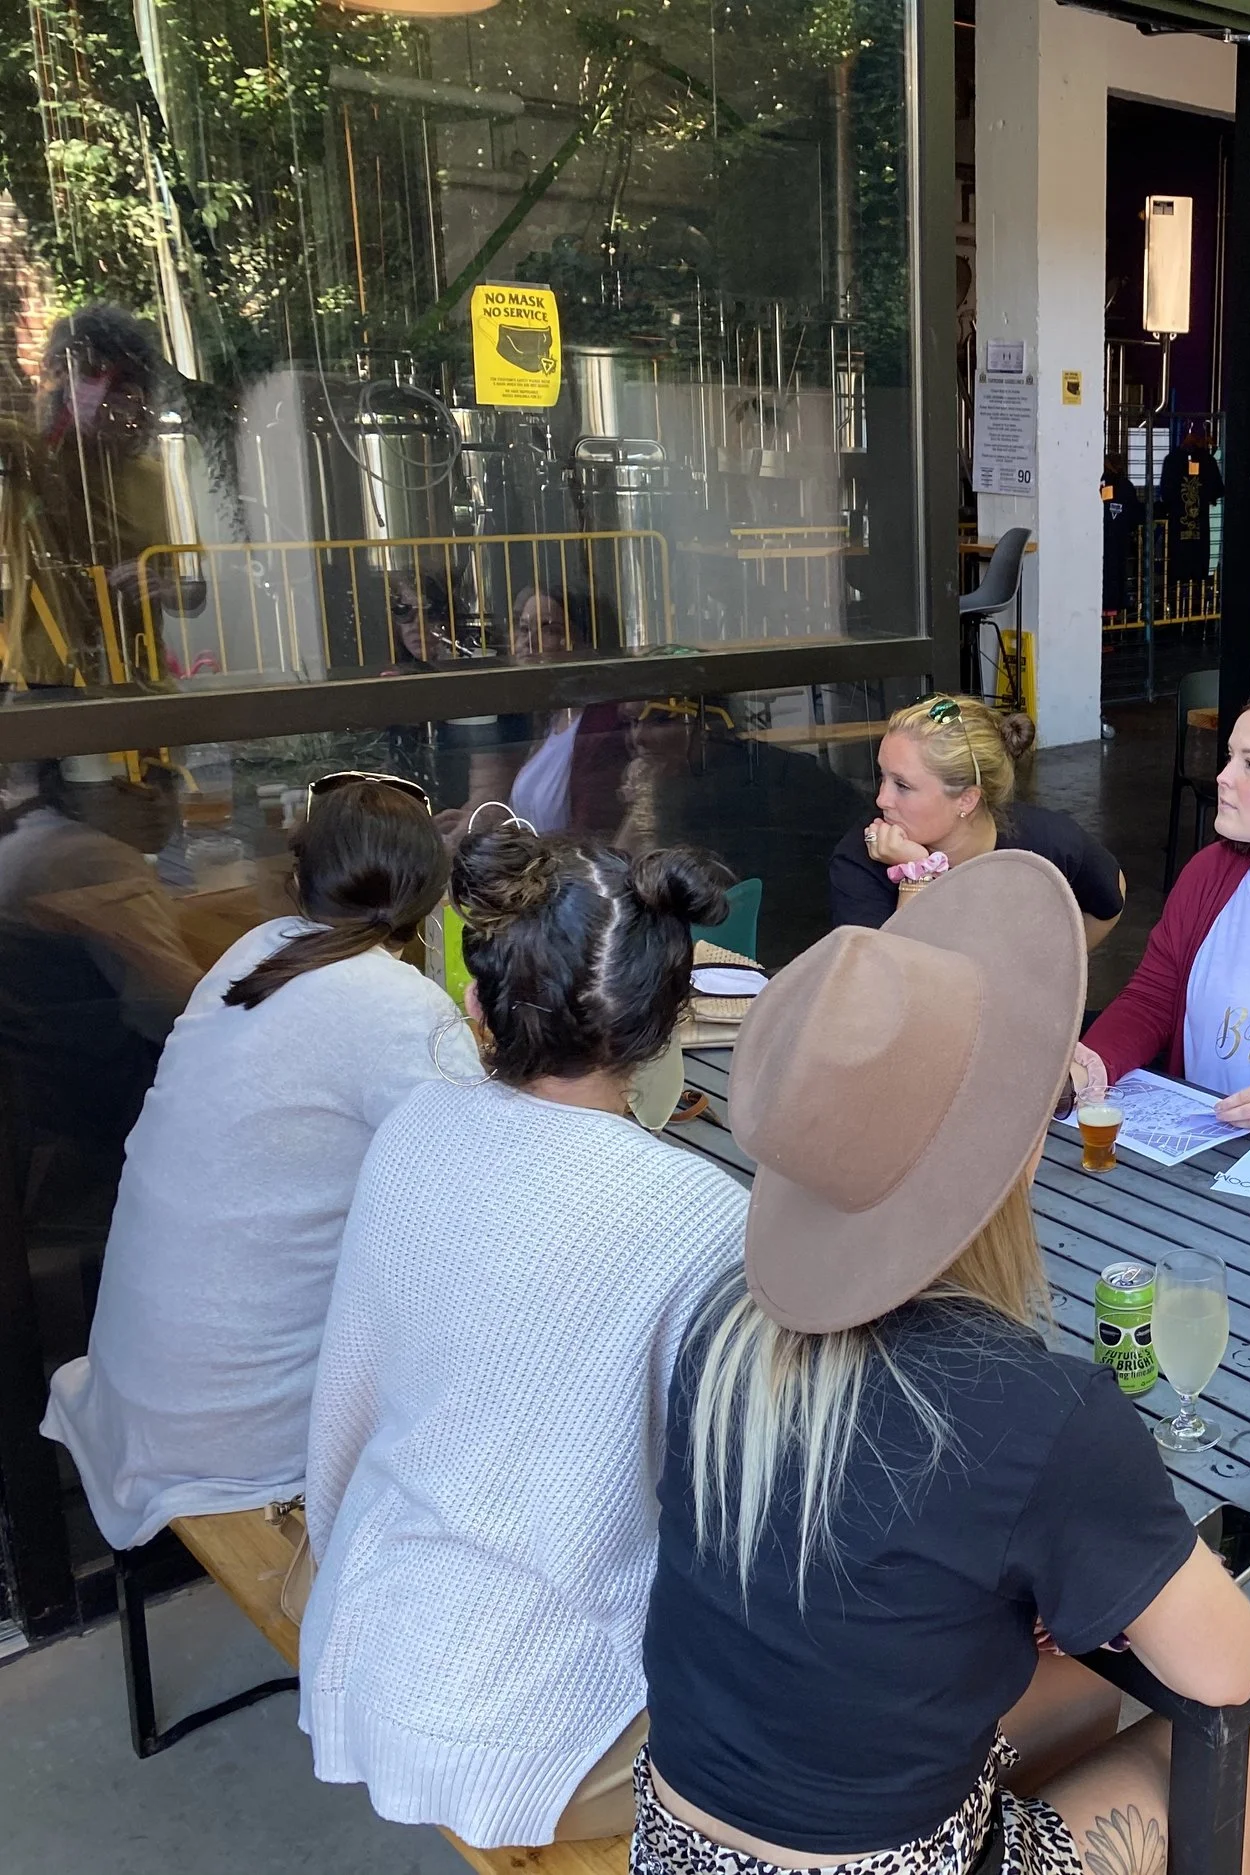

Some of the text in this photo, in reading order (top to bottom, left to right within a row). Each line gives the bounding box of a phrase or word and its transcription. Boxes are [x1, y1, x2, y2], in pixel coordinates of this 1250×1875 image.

[485, 292, 545, 309] NO MASK
[483, 307, 548, 322] NO SERVICE
[1017, 469, 1031, 484] 90
[1116, 1355, 1154, 1371] BRIGHT
